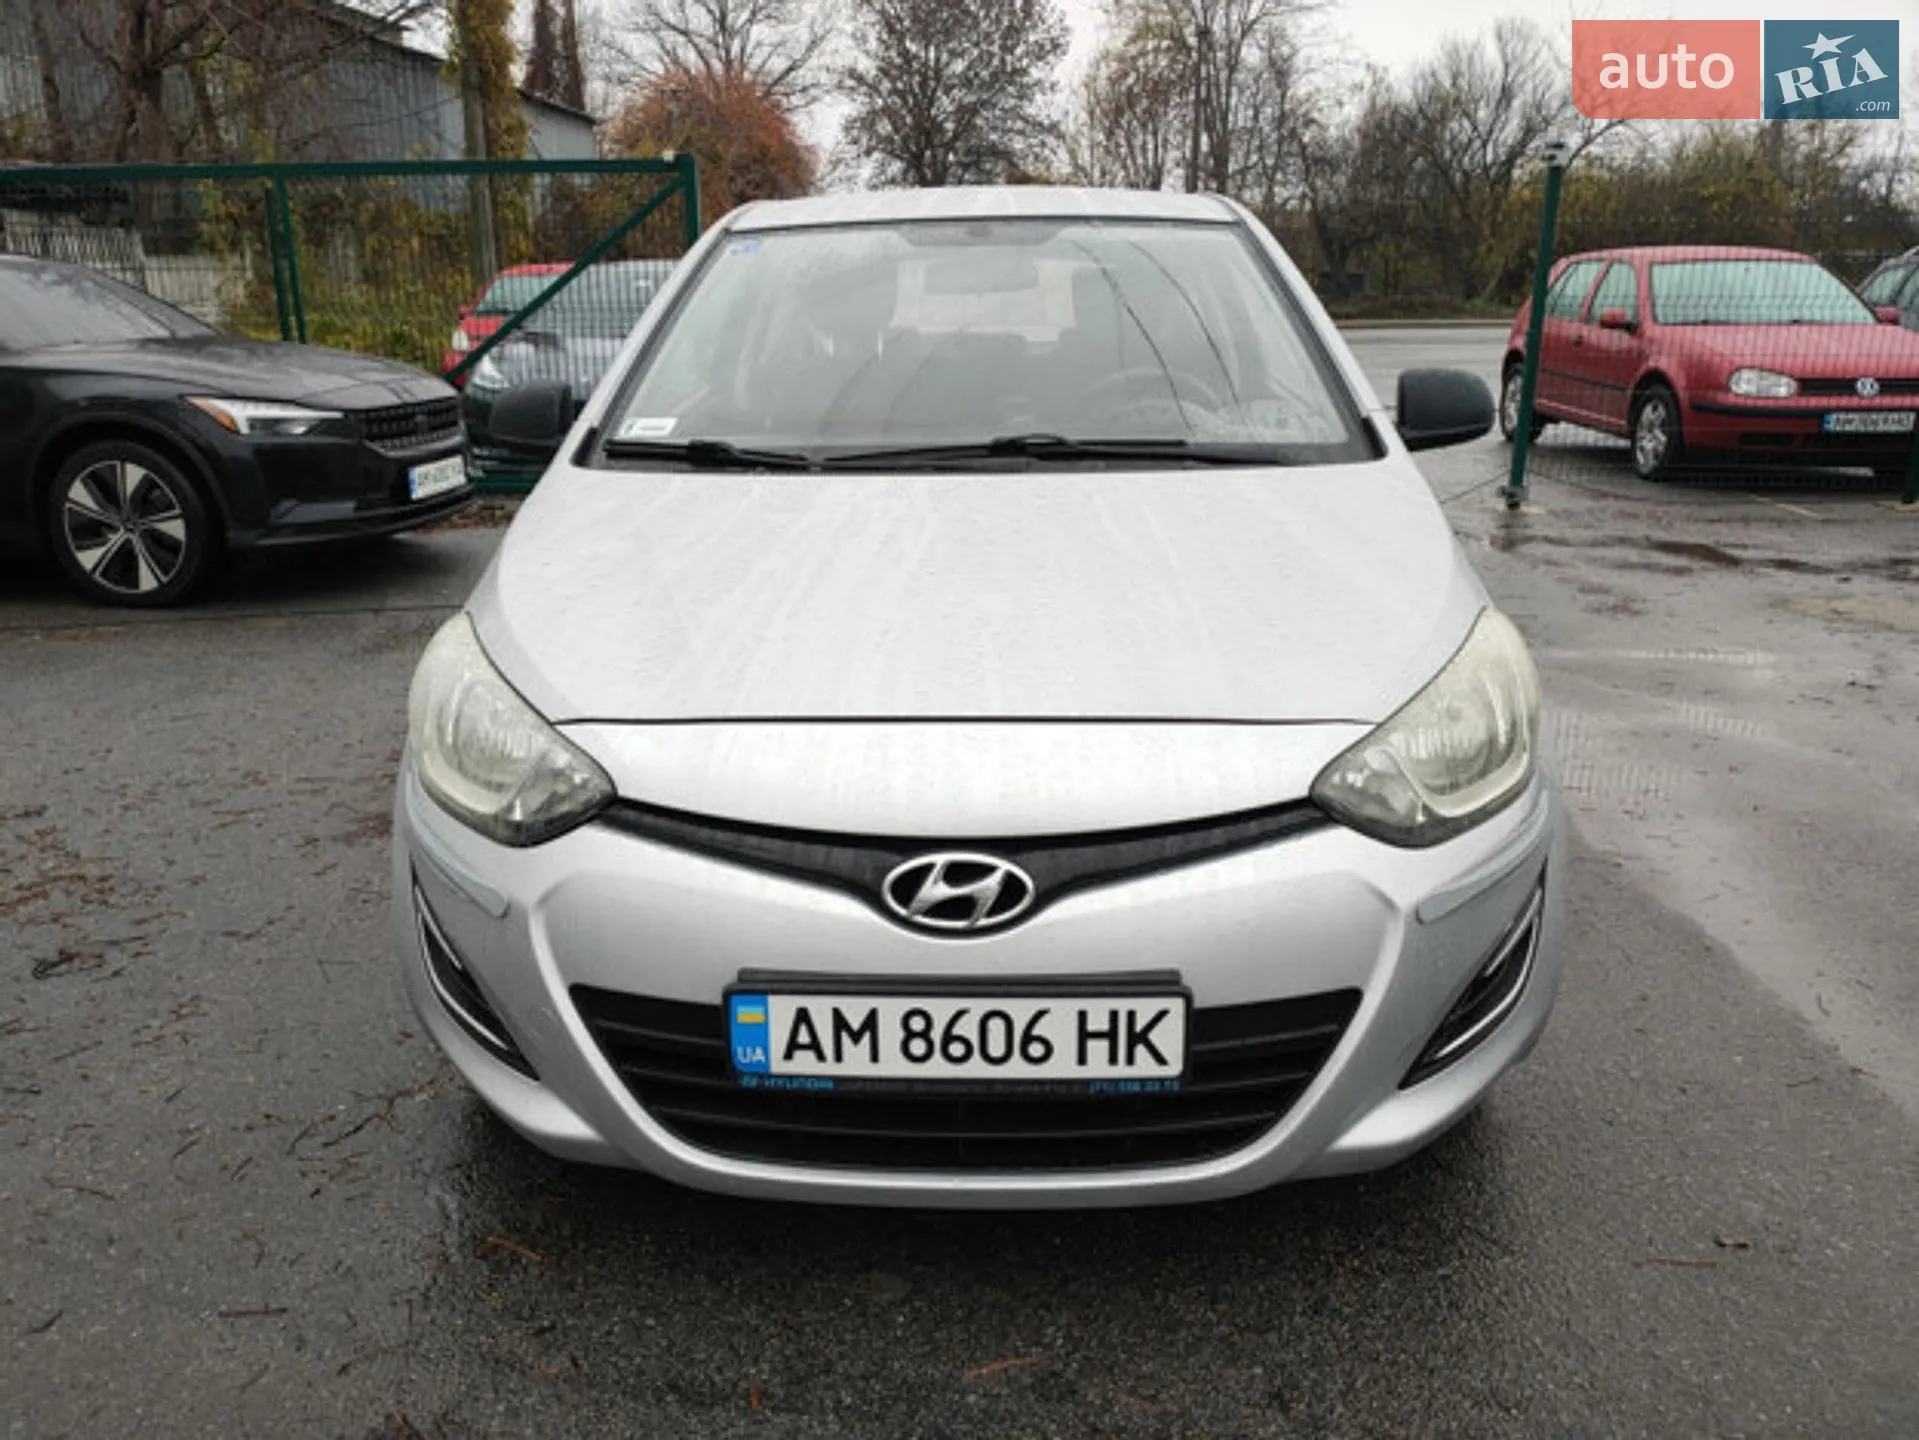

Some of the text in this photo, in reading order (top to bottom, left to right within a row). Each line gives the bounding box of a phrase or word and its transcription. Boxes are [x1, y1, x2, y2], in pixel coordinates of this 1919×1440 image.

[737, 1045, 766, 1064] UA
[782, 1006, 1170, 1067] AM 8606 HK
